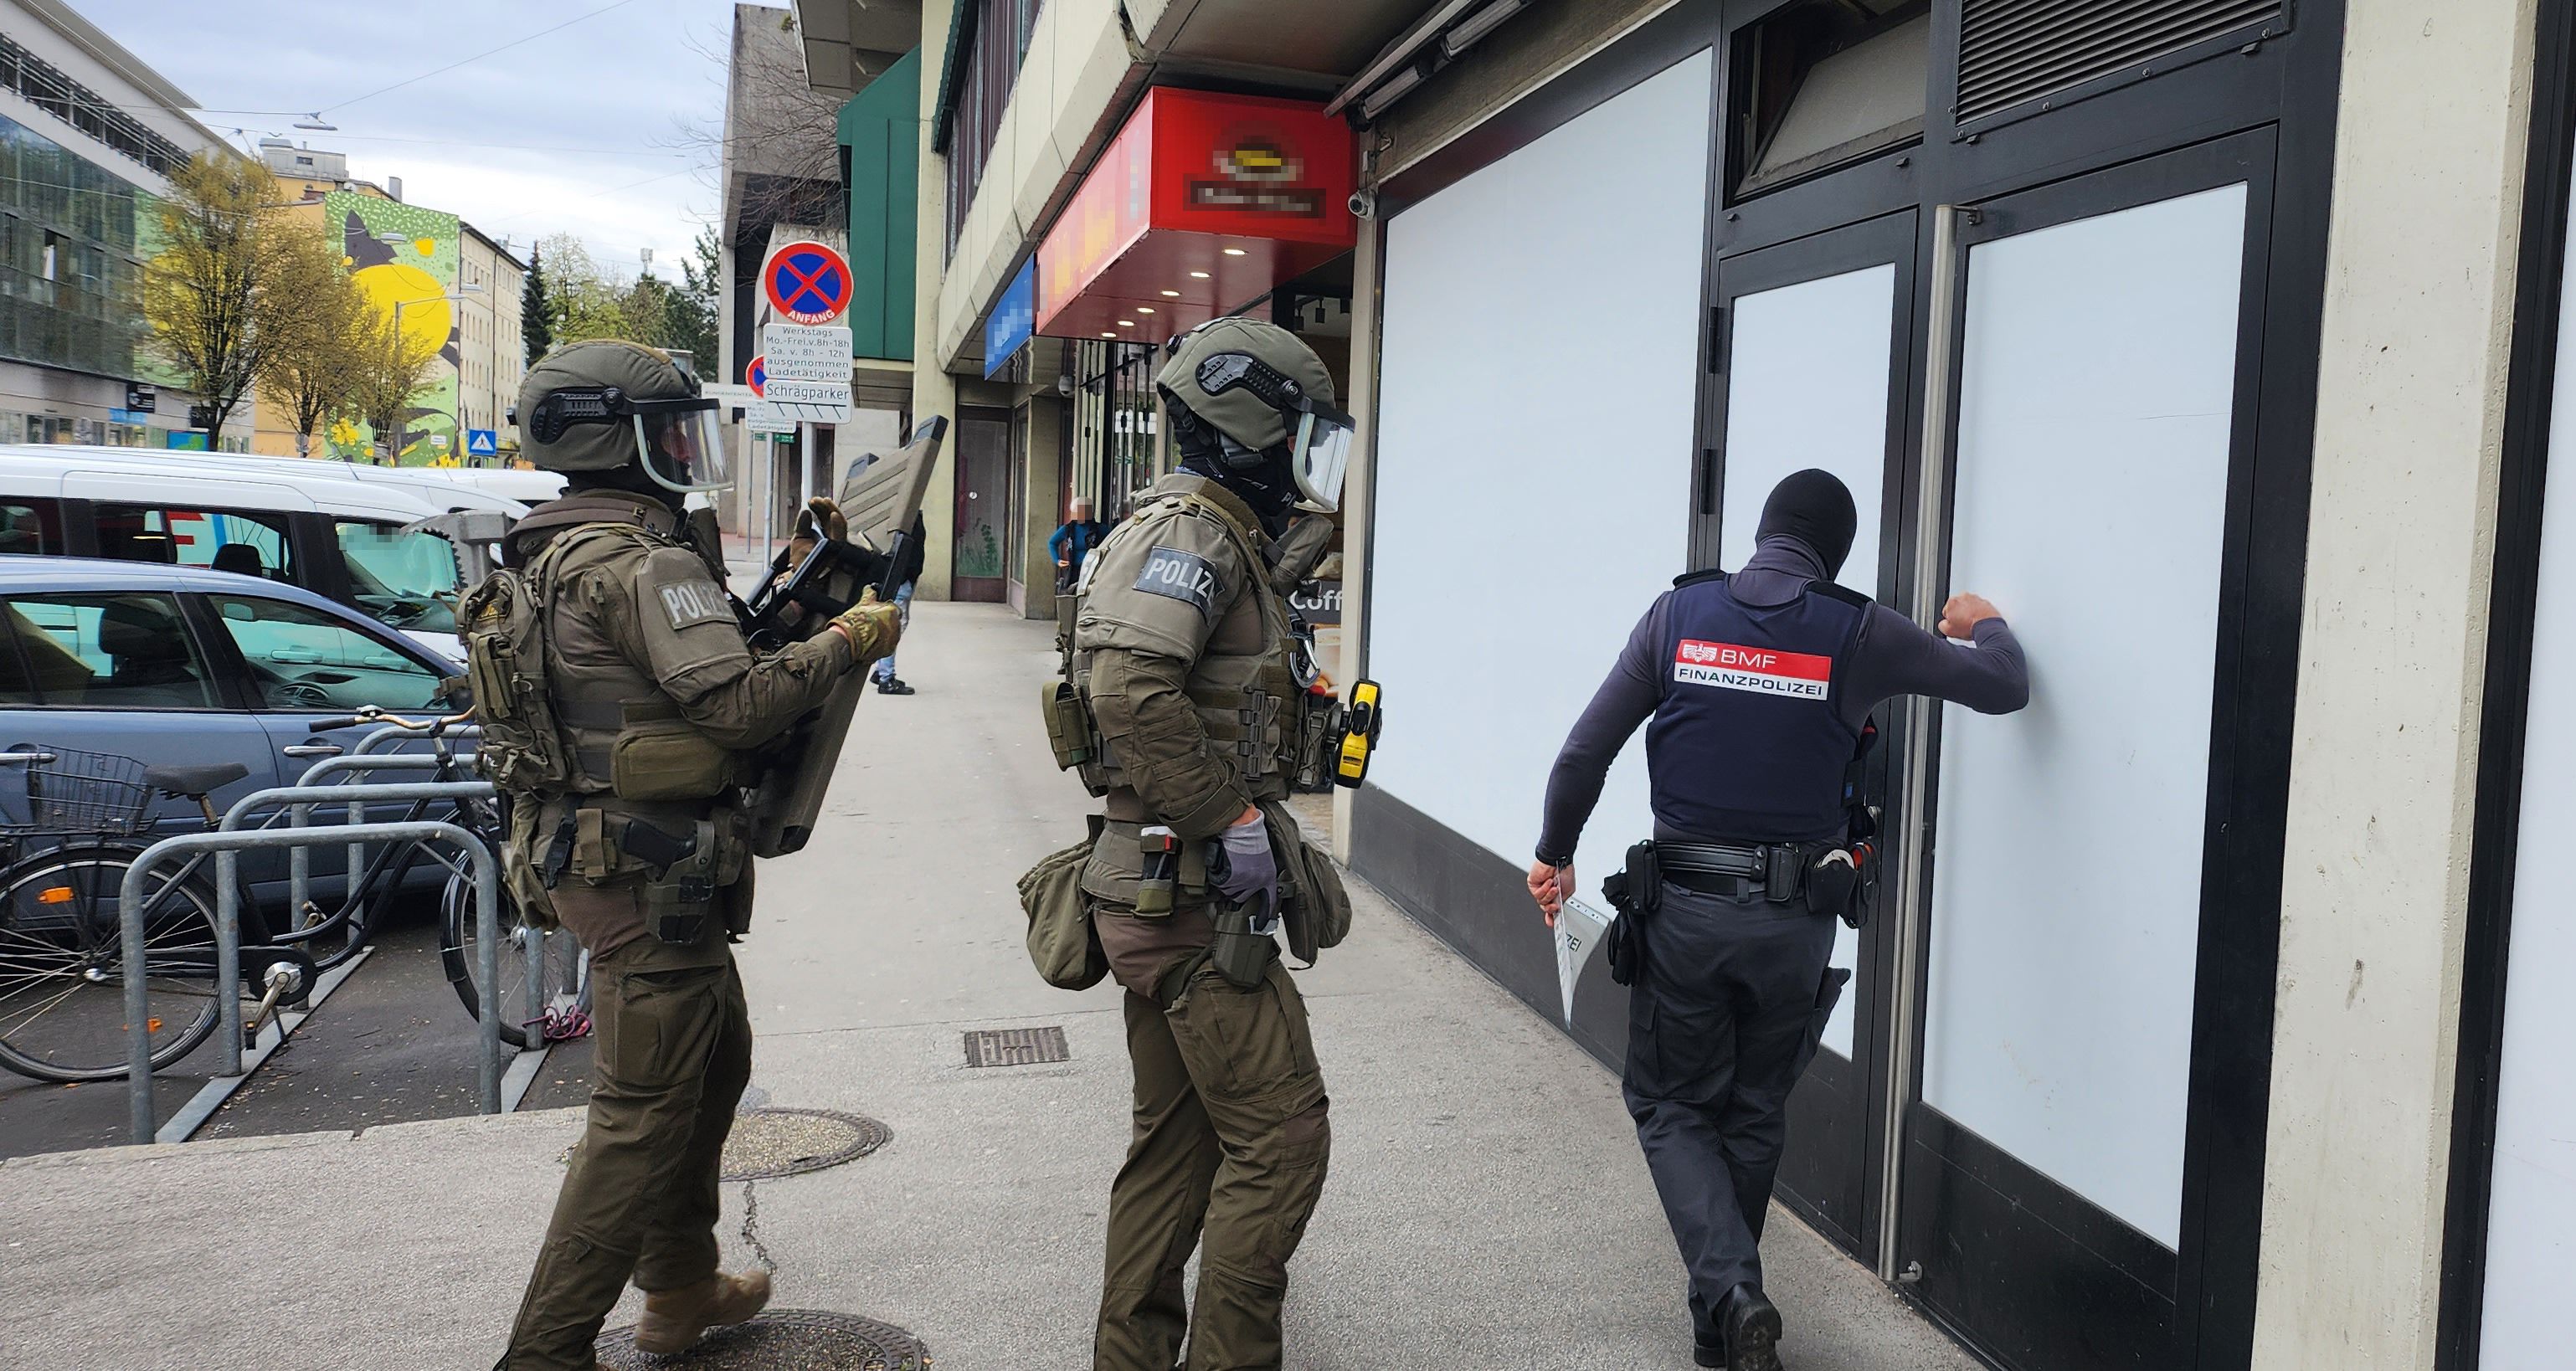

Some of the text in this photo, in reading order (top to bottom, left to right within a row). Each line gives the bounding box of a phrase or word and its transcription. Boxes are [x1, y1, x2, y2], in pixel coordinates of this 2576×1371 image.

[787, 309, 836, 324] ANFANG
[783, 326, 833, 337] Werkstags
[770, 347, 785, 355] Sa.
[803, 348, 815, 357] 8h
[829, 349, 845, 358] 12h
[767, 357, 849, 368] ausgenommen
[769, 367, 847, 379] Ladetätigkeit
[767, 383, 849, 400] Schrägparker
[1289, 589, 1344, 611] Coff
[1720, 649, 1777, 669] BMF
[1679, 668, 1823, 696] FINANZPOLIZEI
